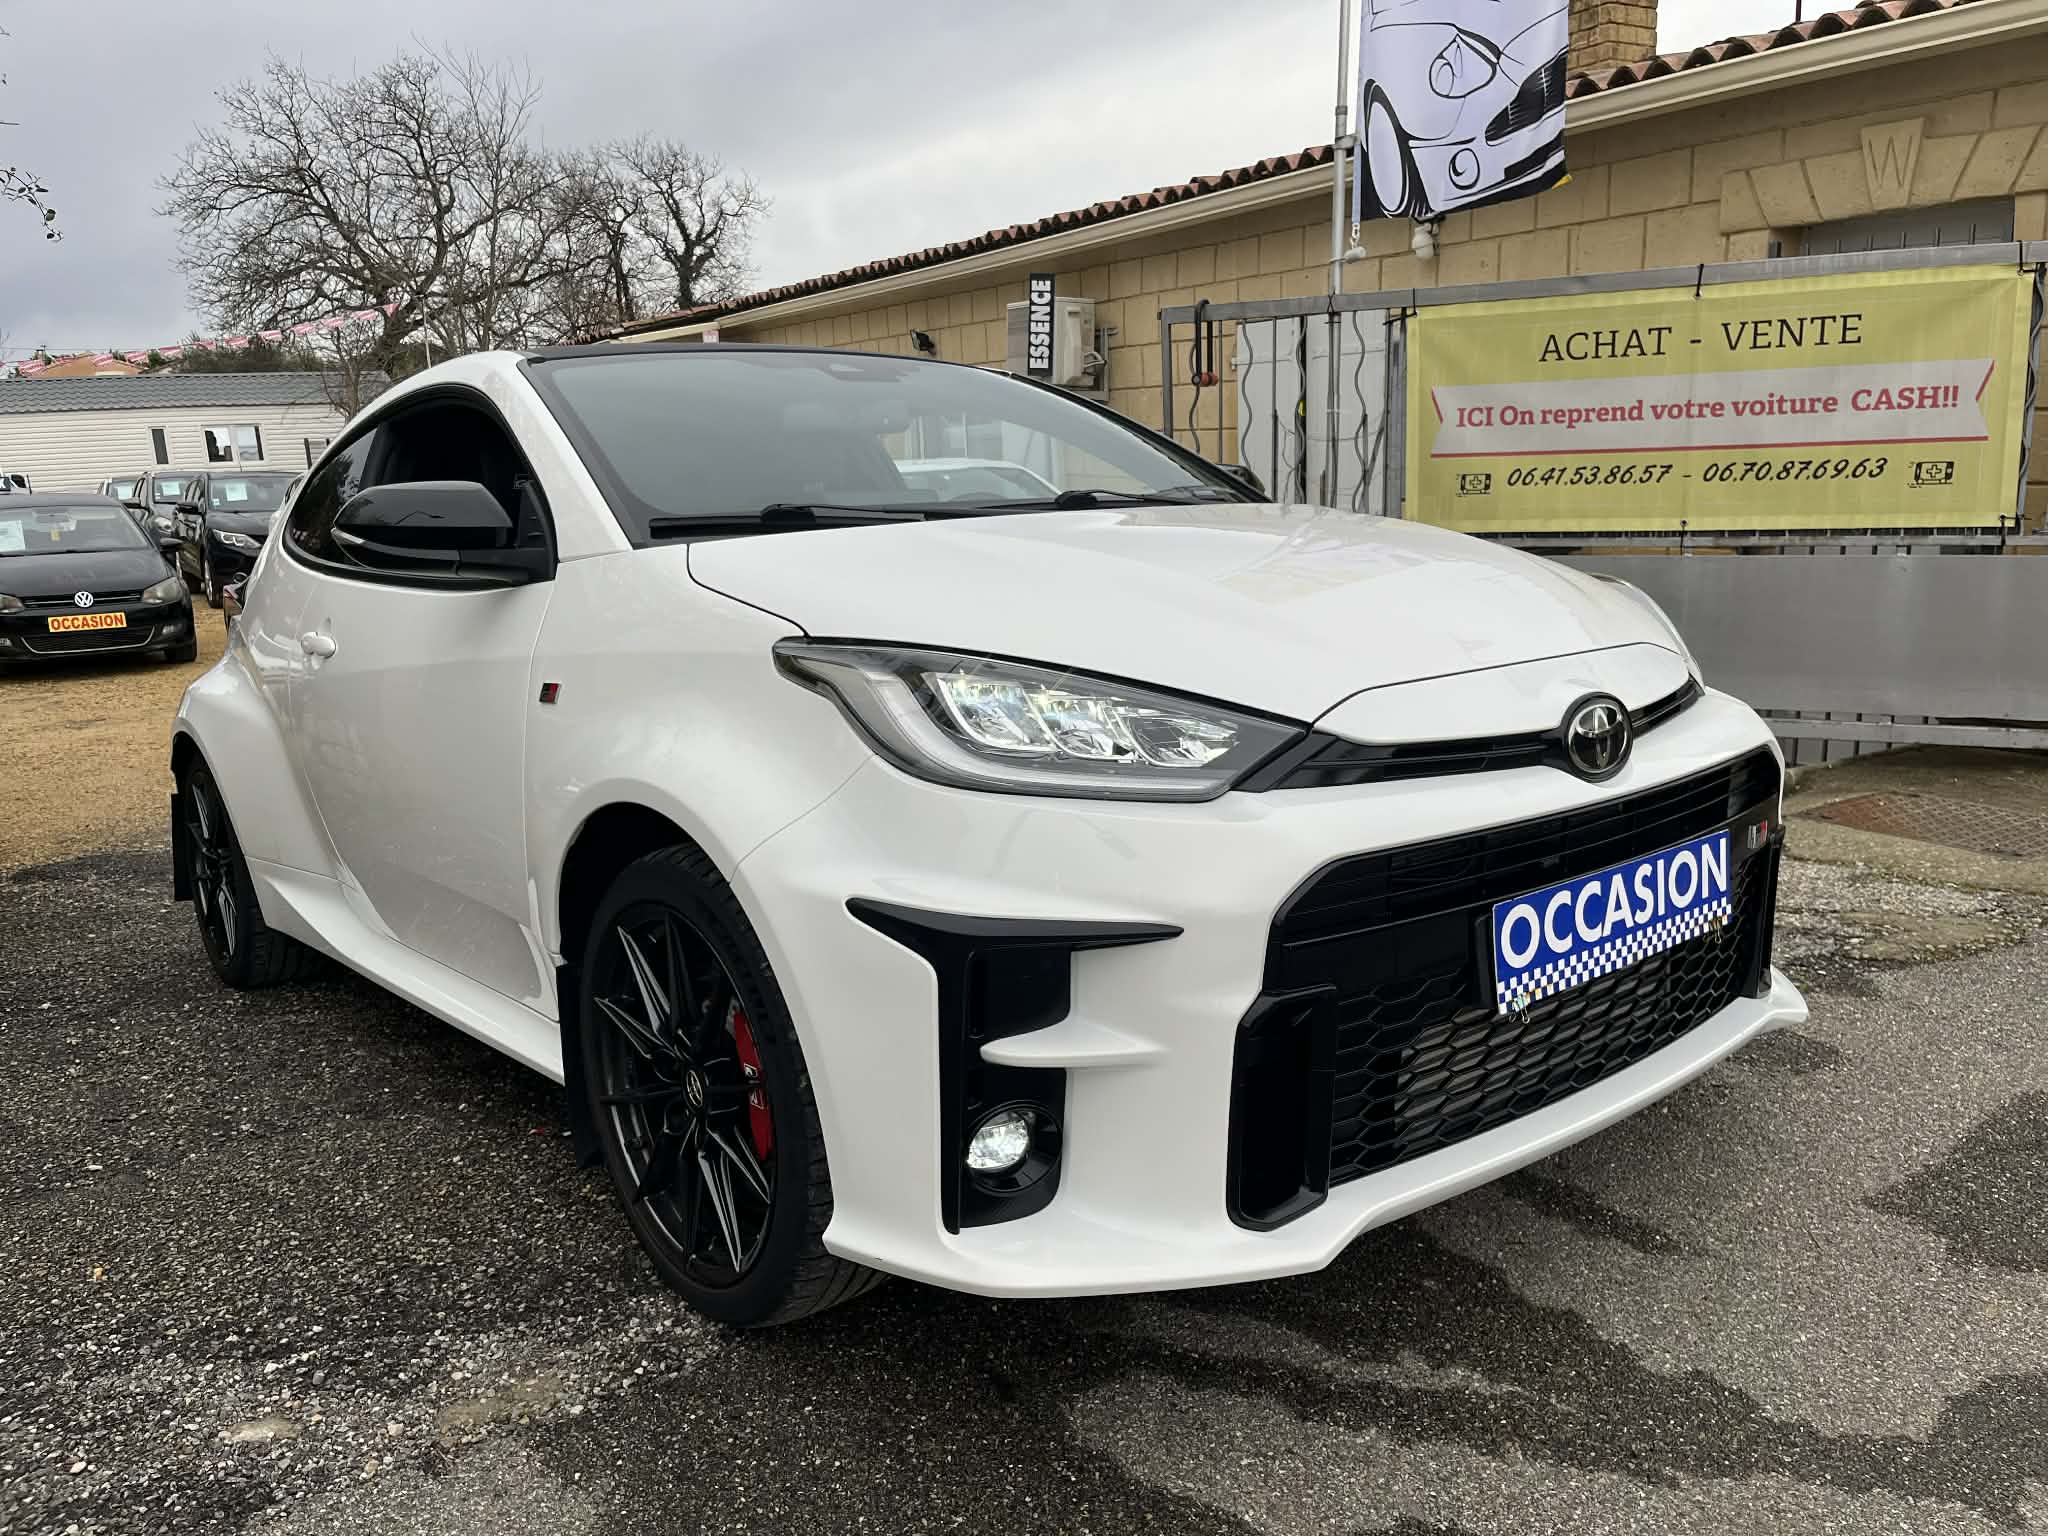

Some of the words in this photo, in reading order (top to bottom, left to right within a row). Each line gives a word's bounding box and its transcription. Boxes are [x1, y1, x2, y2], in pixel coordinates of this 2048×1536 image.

[1029, 279, 1052, 369] ESSENCE
[1538, 326, 1673, 363] ACHAT
[1720, 313, 1864, 351] VENTE
[1456, 406, 1494, 428] ICI
[1499, 405, 1536, 427] On
[1540, 400, 1644, 430] reprend
[1650, 399, 1726, 421] votre
[1731, 393, 1841, 417] voiture
[1850, 384, 1961, 412] CASH!!
[1506, 463, 1674, 487] 06.41.53.86.57
[1702, 457, 1890, 483] 06.70.87.69.63
[50, 614, 125, 632] OCCASION
[1500, 837, 1728, 969] OCCASION
